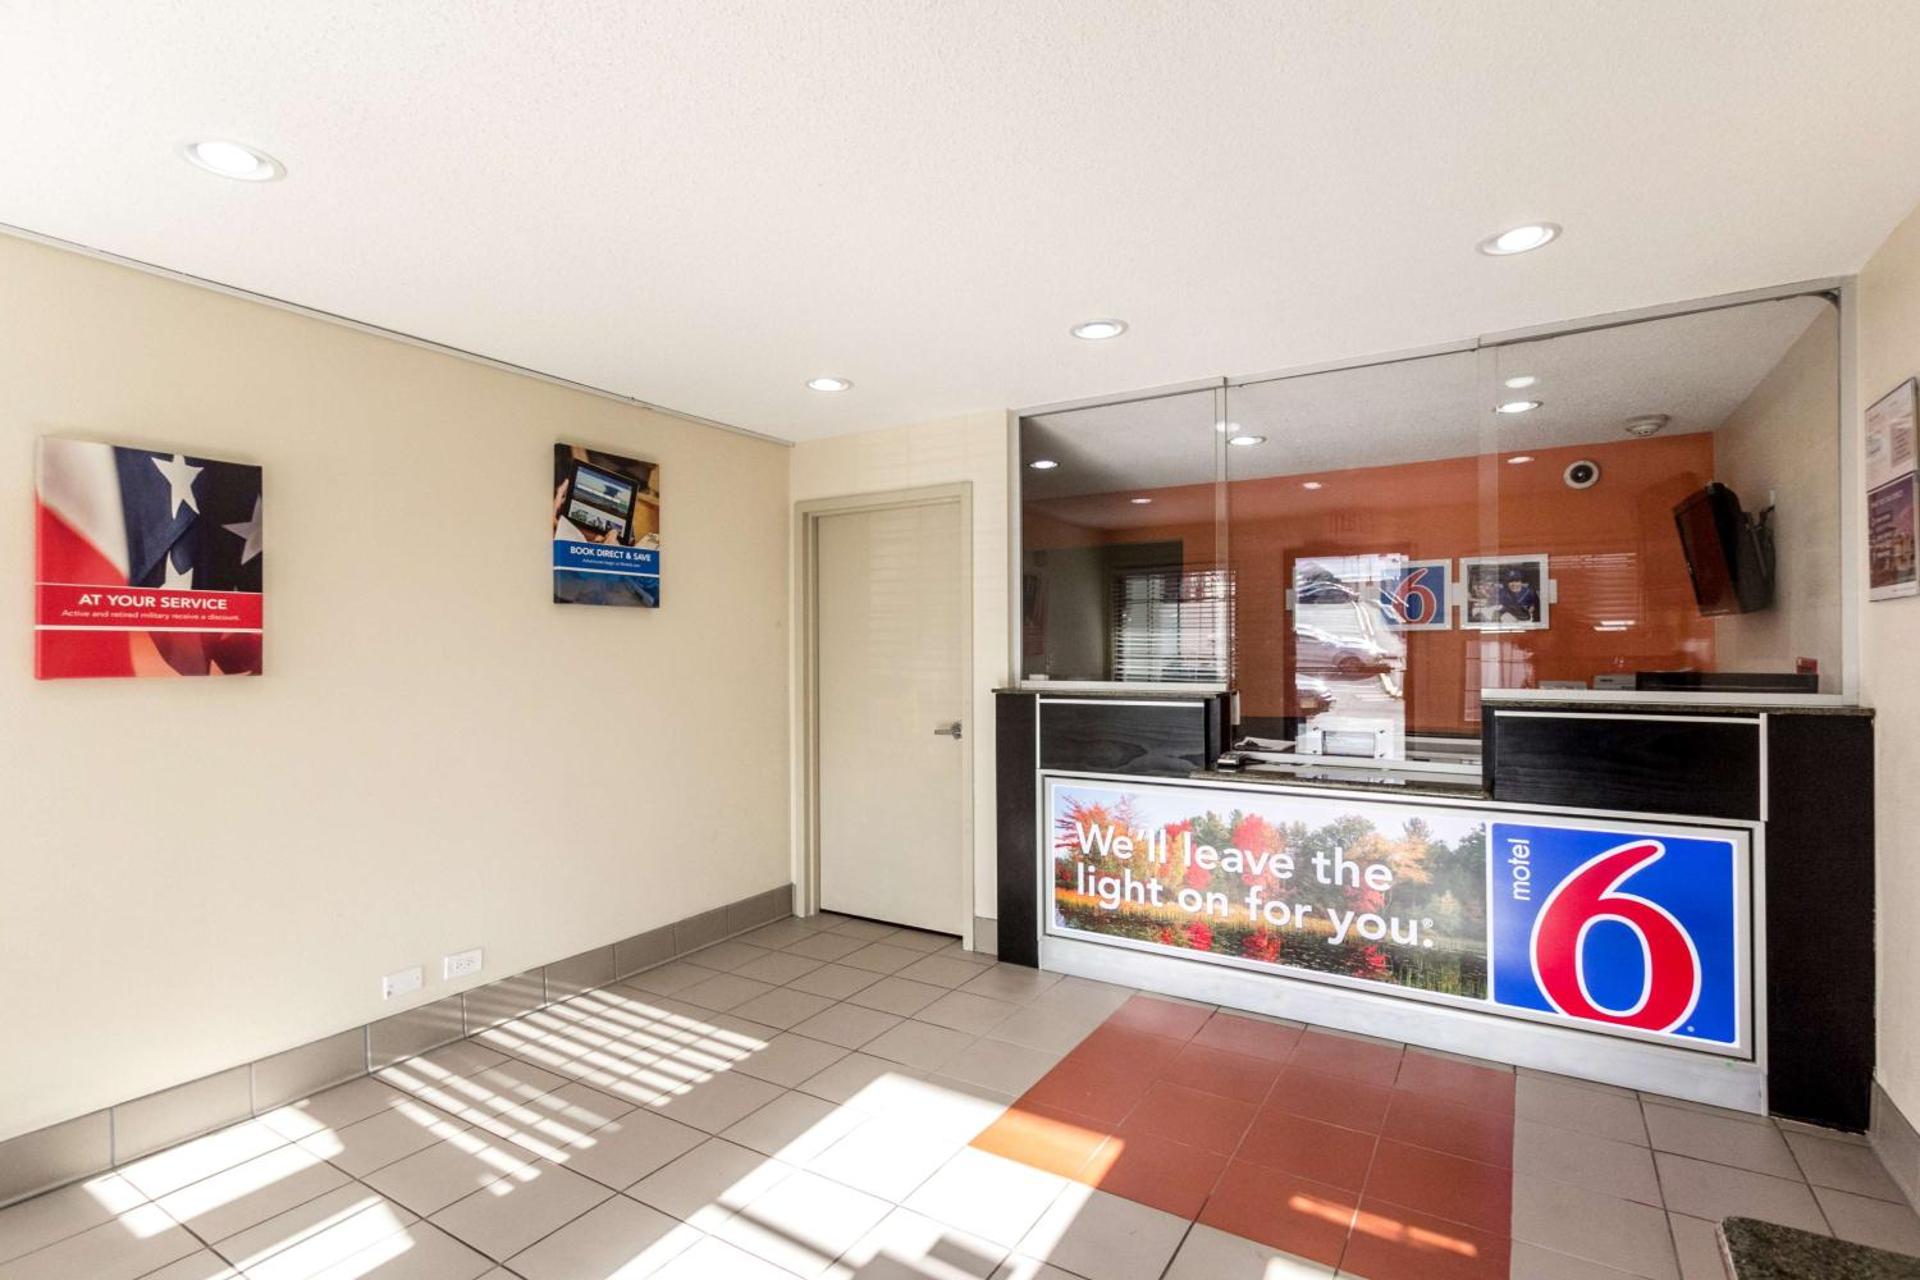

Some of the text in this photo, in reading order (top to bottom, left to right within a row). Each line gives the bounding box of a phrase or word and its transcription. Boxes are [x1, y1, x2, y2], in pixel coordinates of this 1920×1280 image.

[570, 546, 651, 562] BOOK DIRECT & SAVE
[61, 609, 90, 617] Active
[79, 594, 227, 610] AT YOUR SERVICE
[1392, 567, 1437, 624] 6
[1076, 823, 1393, 891] We'll leave the
[1507, 838, 1530, 900] motel
[1077, 862, 1164, 909] light
[1178, 889, 1229, 917] on
[1246, 886, 1312, 929] for
[1529, 839, 1702, 1034] 6
